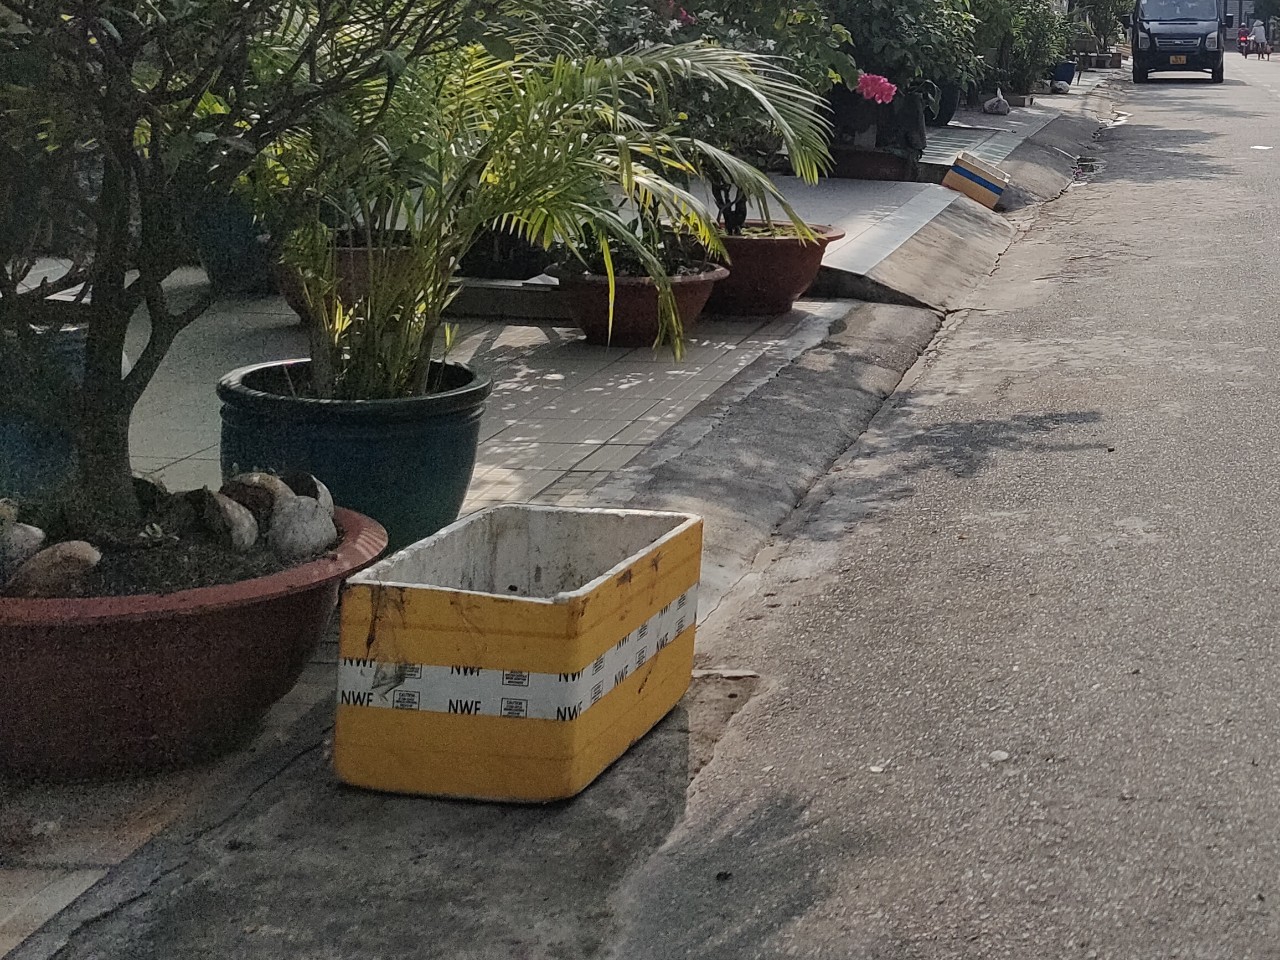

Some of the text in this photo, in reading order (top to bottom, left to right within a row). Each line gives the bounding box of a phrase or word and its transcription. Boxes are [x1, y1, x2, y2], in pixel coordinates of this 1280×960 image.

[340, 690, 374, 708] NWF
[448, 698, 482, 716] NWF
[556, 700, 583, 721] NWF
